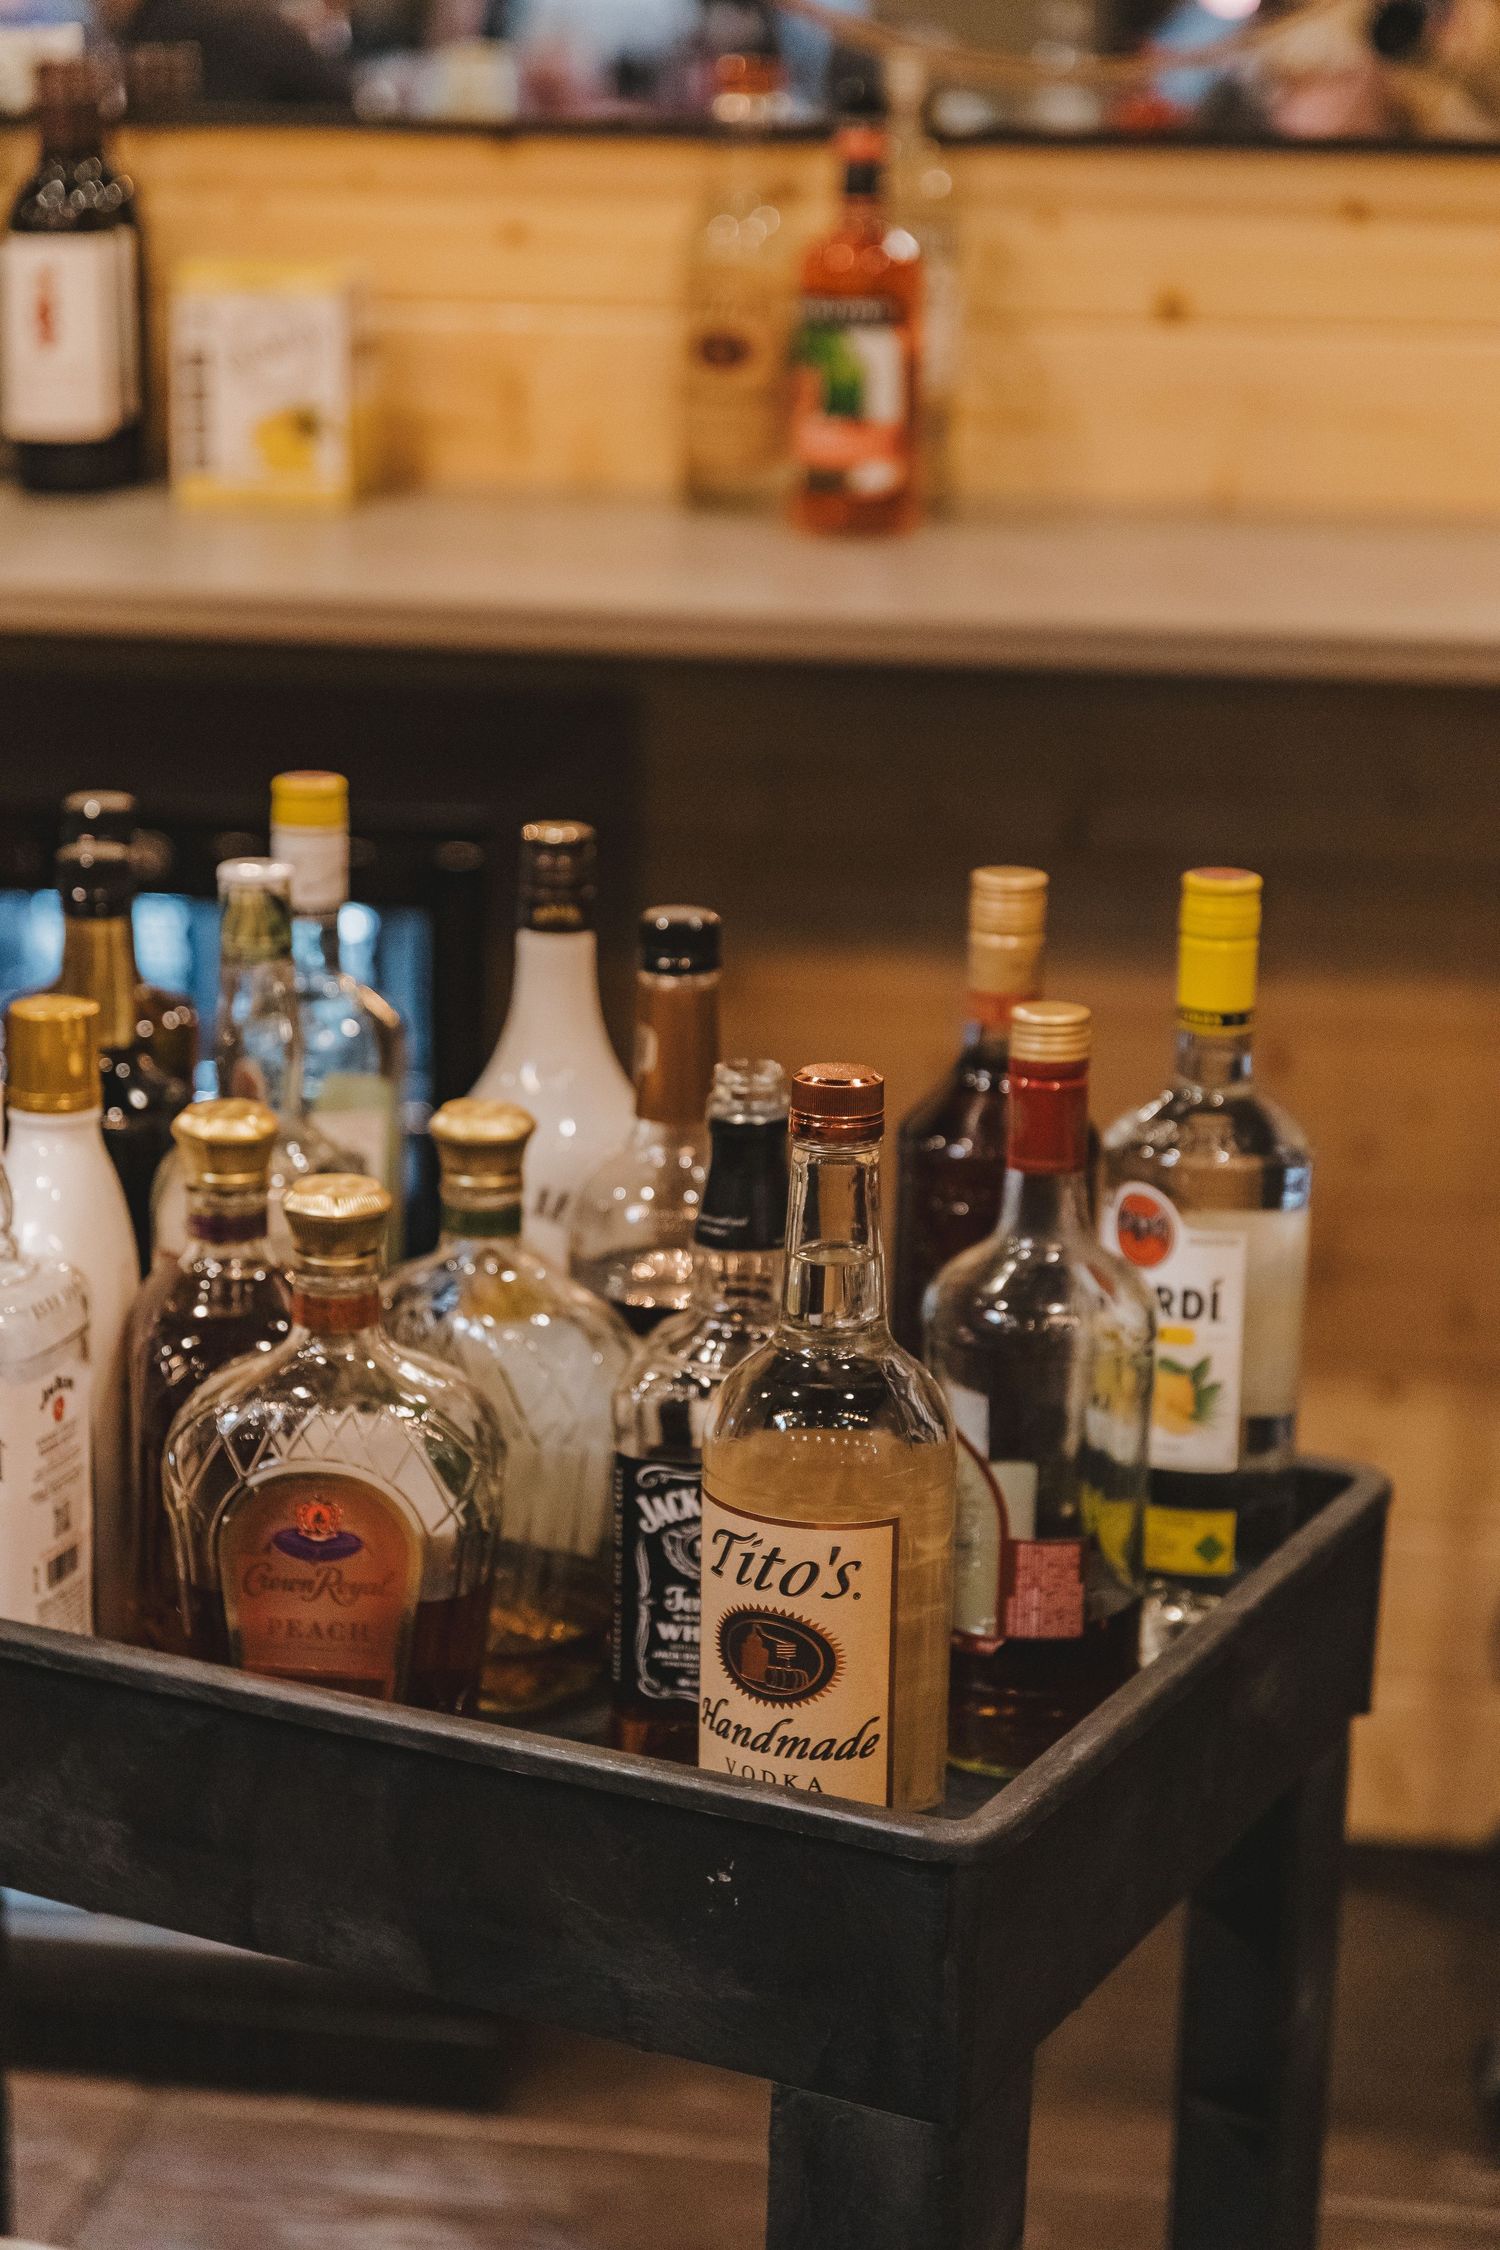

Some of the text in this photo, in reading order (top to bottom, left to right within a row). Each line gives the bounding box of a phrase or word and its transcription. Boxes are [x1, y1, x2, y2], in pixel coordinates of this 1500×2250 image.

[1156, 1278, 1222, 1322] RDÍ
[711, 1528, 862, 1600] Tito's
[266, 1616, 369, 1641] PEACH
[702, 1697, 881, 1762] Handmade
[725, 1757, 823, 1793] VODKA
